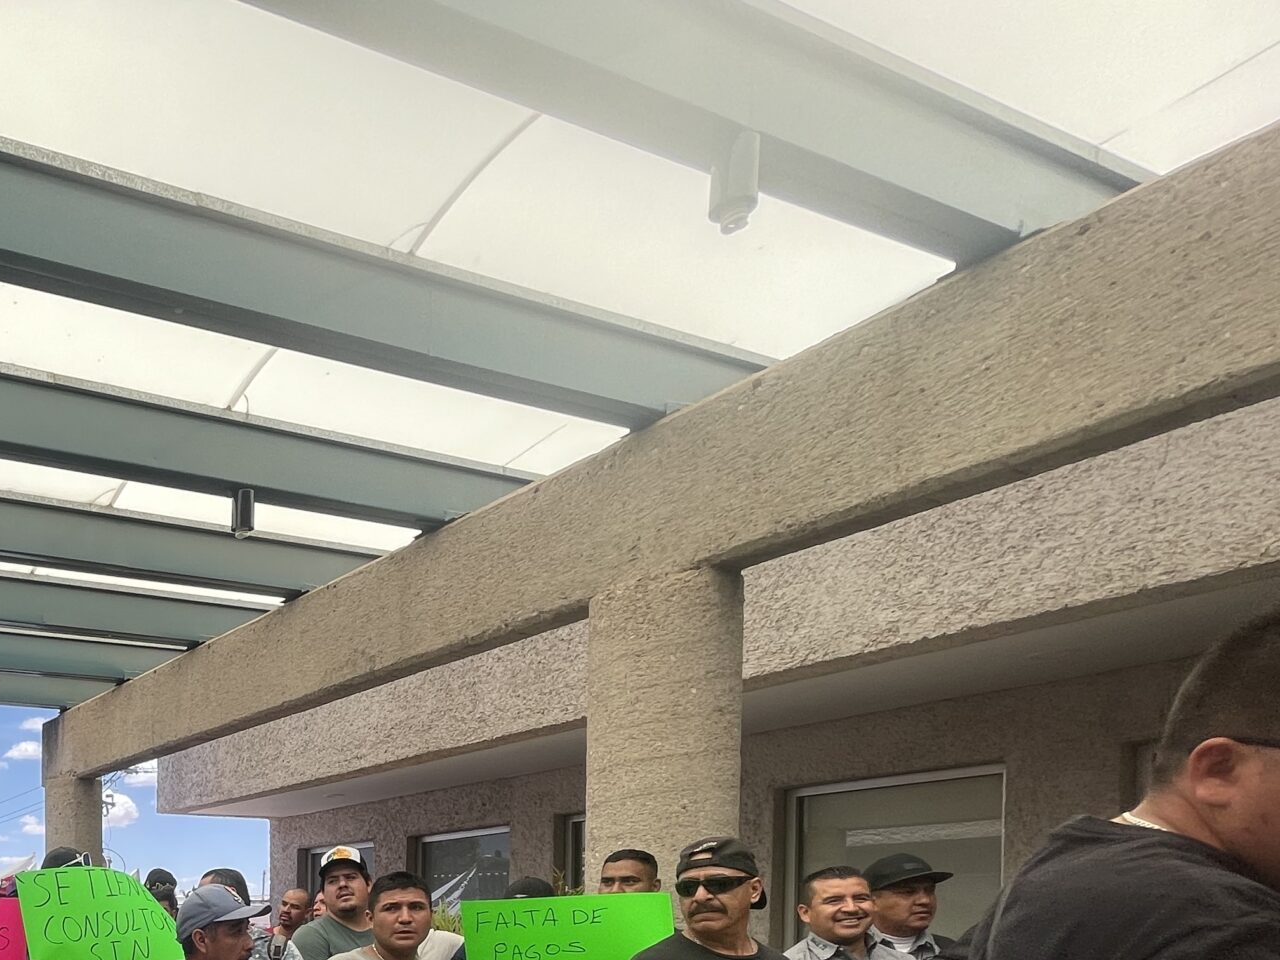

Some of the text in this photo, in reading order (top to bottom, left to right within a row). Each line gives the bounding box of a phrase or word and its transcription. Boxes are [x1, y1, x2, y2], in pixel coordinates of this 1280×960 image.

[33, 870, 71, 908] SE
[475, 907, 608, 934] FALTA DE
